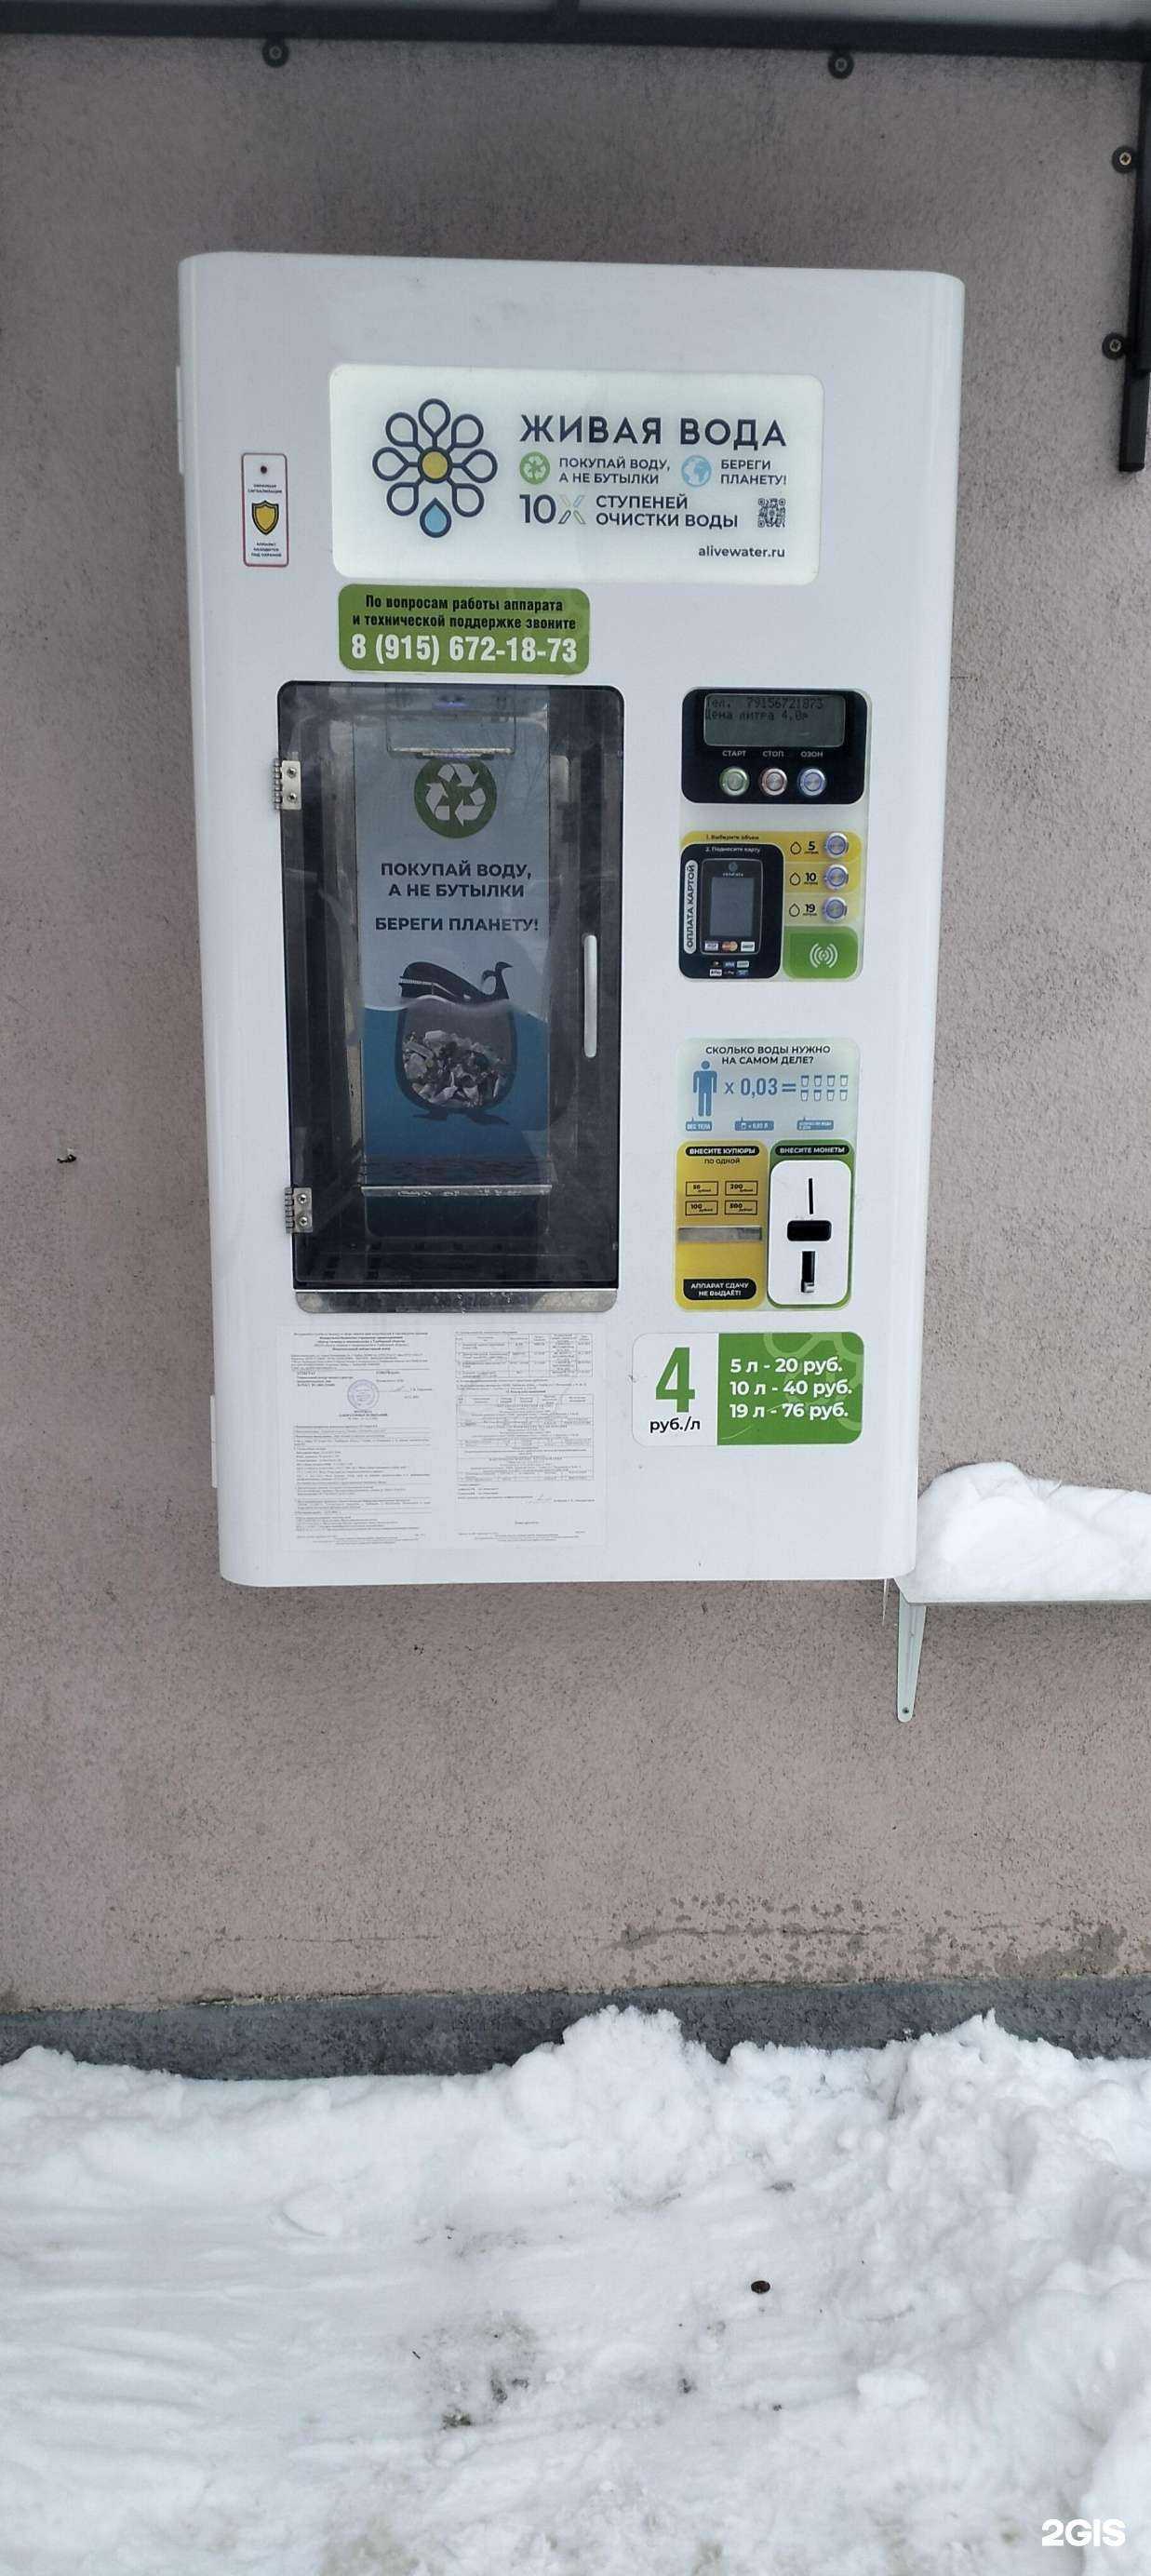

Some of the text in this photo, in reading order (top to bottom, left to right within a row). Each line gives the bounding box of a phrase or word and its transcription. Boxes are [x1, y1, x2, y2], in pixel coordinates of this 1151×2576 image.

[519, 414, 786, 450] ЖИВАЯ ВОДА
[559, 456, 670, 472] ПОКУПАЙ ВОДУ,
[721, 459, 770, 470] БЕРЕГИ
[559, 473, 659, 485] А НЕ БУТЫЛКИ
[720, 475, 786, 485] ПЛАНЕТУ!
[596, 493, 688, 509] СТУПЕНЕЙ
[596, 512, 738, 530] ОЧИСТКИ ВОДЫ
[699, 545, 785, 557] alivewater.ru
[366, 595, 563, 614] По вопросам работы аппарата
[353, 614, 576, 630] и технической поддержке звоните
[352, 634, 577, 665] 8 (915) 672-18-73
[722, 750, 746, 758] СТАРТ
[808, 841, 815, 851] 5
[381, 861, 531, 879] ПОКУПАЙ ВОДУ,
[806, 872, 817, 881] 10
[389, 884, 525, 898] А НЕ БУТЫЛКИ
[687, 865, 695, 905] КАРТОЙ
[805, 904, 816, 913] 19
[375, 918, 539, 932] БЕРЕГИ ПЛАНЕТУ!
[705, 1045, 831, 1055] СКОЛЬКО ВОДЫ НУЖНО
[722, 1056, 814, 1066] НА САМОМ ДЕЛЕ?
[741, 1078, 778, 1098] 0,03
[730, 1359, 742, 1373] 5
[745, 1361, 758, 1373] л
[775, 1358, 798, 1373] 20
[803, 1357, 843, 1375] руб.
[655, 1347, 696, 1413] 4
[729, 1381, 749, 1396] 10
[754, 1383, 767, 1395] л
[783, 1381, 808, 1395] 40
[813, 1379, 852, 1398] руб.
[729, 1403, 748, 1418] 19
[753, 1405, 766, 1417] л
[782, 1403, 805, 1418] 76
[810, 1402, 849, 1420] руб.
[649, 1416, 701, 1434] руб./л
